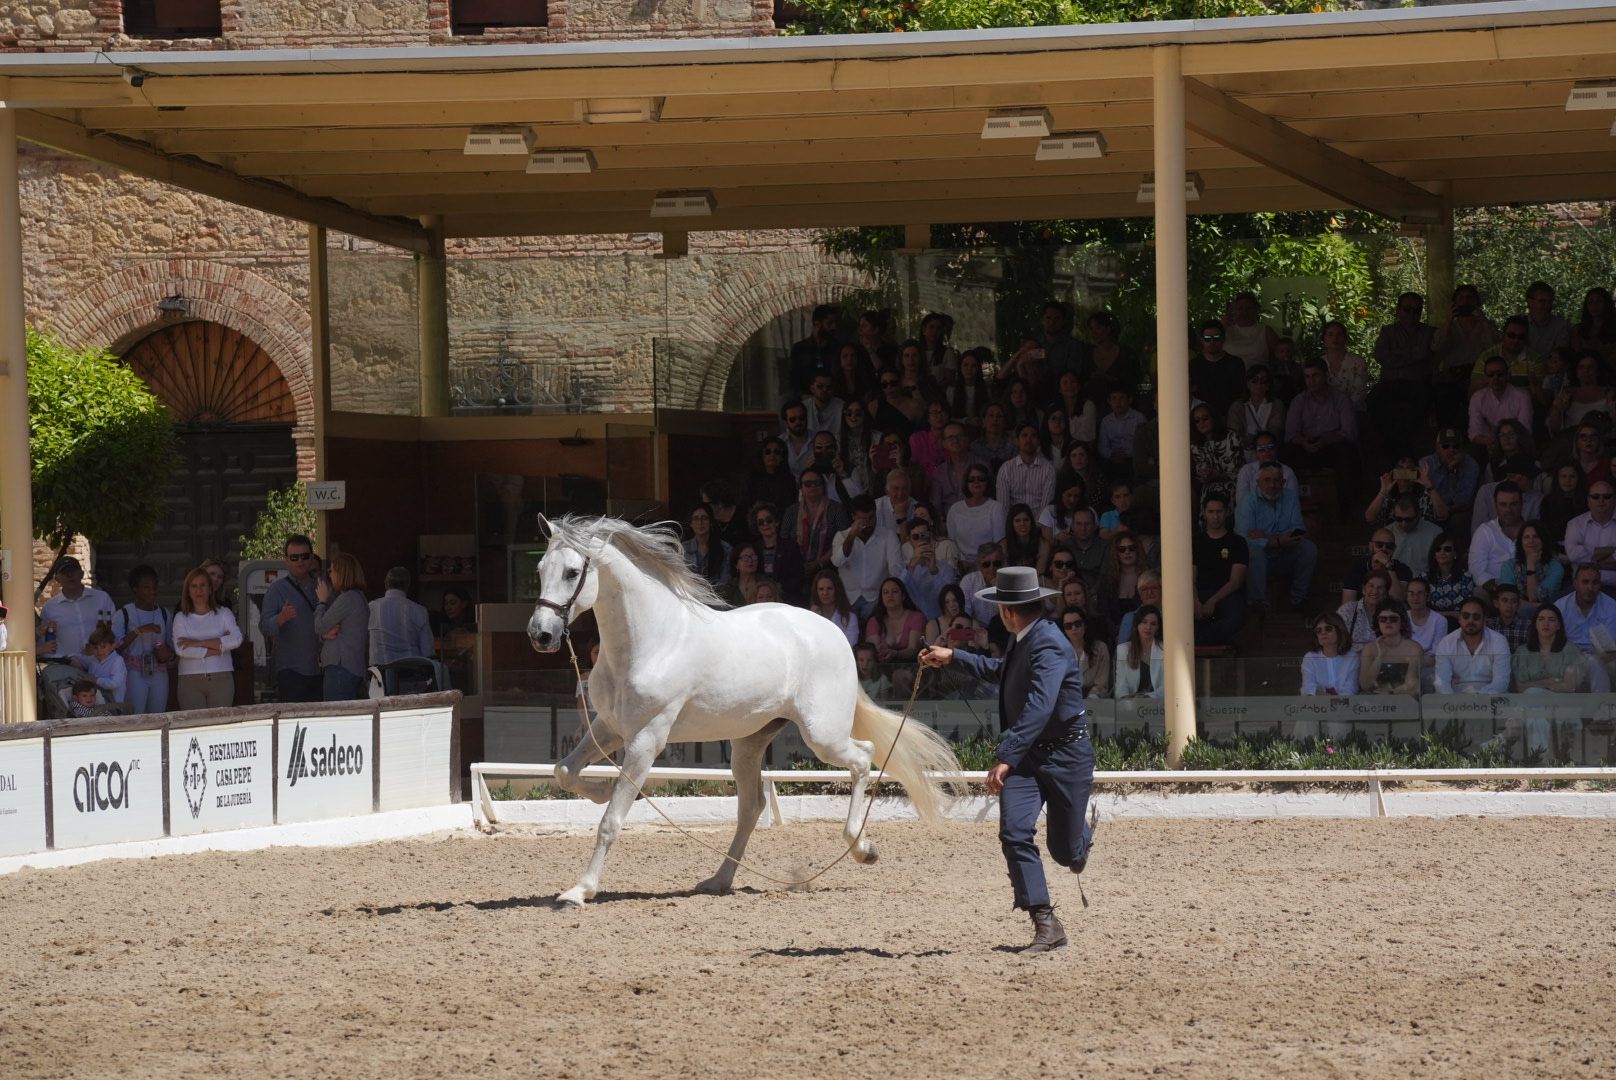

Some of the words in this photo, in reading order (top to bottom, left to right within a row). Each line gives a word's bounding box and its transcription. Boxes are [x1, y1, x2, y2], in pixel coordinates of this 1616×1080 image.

[315, 489, 341, 500] W.C.
[209, 740, 258, 762] RESTAURANTE
[310, 733, 363, 778] sadeco
[215, 769, 234, 787] CASA
[233, 766, 252, 785] PEPE
[216, 795, 223, 808] DE
[223, 794, 231, 807] LA
